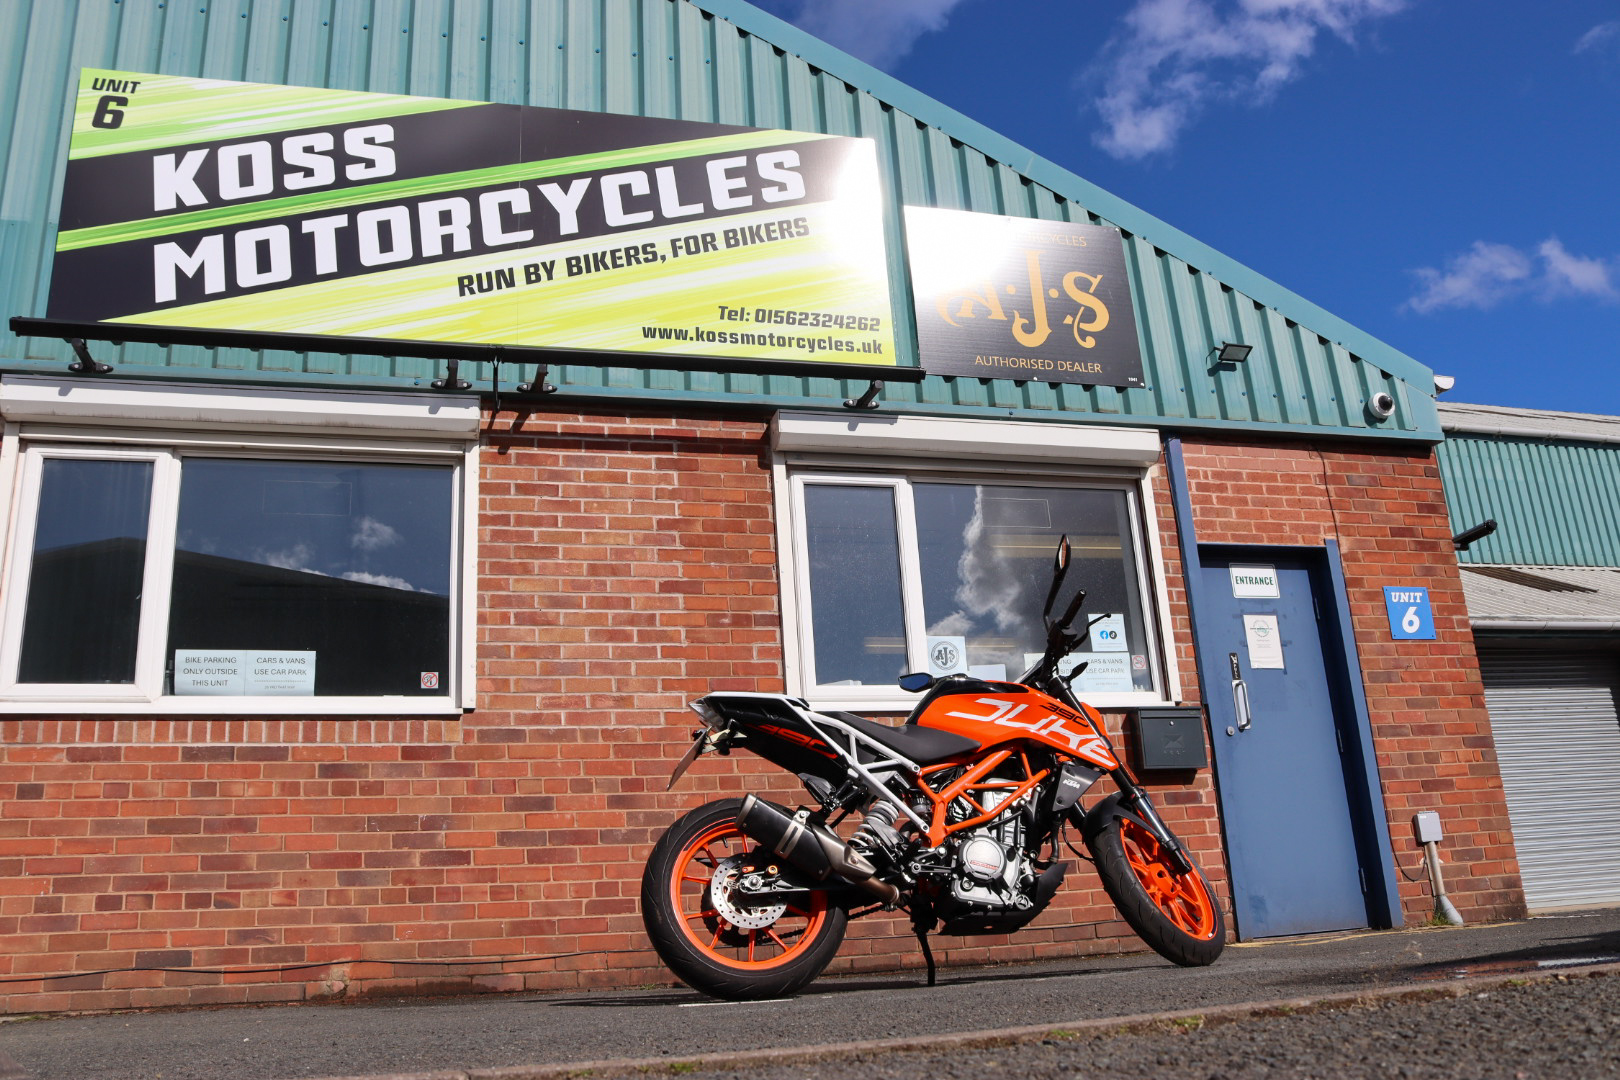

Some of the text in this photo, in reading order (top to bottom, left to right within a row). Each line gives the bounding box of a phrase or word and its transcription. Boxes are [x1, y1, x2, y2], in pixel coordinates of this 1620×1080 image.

[91, 77, 140, 94] UNIT
[91, 95, 129, 130] 6
[153, 123, 397, 211] KOSS
[153, 150, 806, 303] MOTORCYCLES
[457, 217, 810, 297] RUN BY BIKERS, FOR BIKERS
[718, 305, 881, 332] Tel: 01562324262
[642, 325, 883, 355] www.kossmotorcycles.uk
[975, 355, 1103, 374] AUTHORISED DEALER
[1235, 575, 1275, 587] ENTRANCE
[1391, 592, 1424, 603] UNIT
[1402, 606, 1421, 634] 6
[185, 656, 237, 664] BIKE PARKING
[285, 657, 306, 665] VANS
[183, 667, 238, 675] ONLY OUTSIDE
[287, 668, 307, 676] PARK
[192, 679, 228, 687] THIS UNIT
[945, 697, 1117, 767] DUKE
[1062, 778, 1081, 789] KTM
